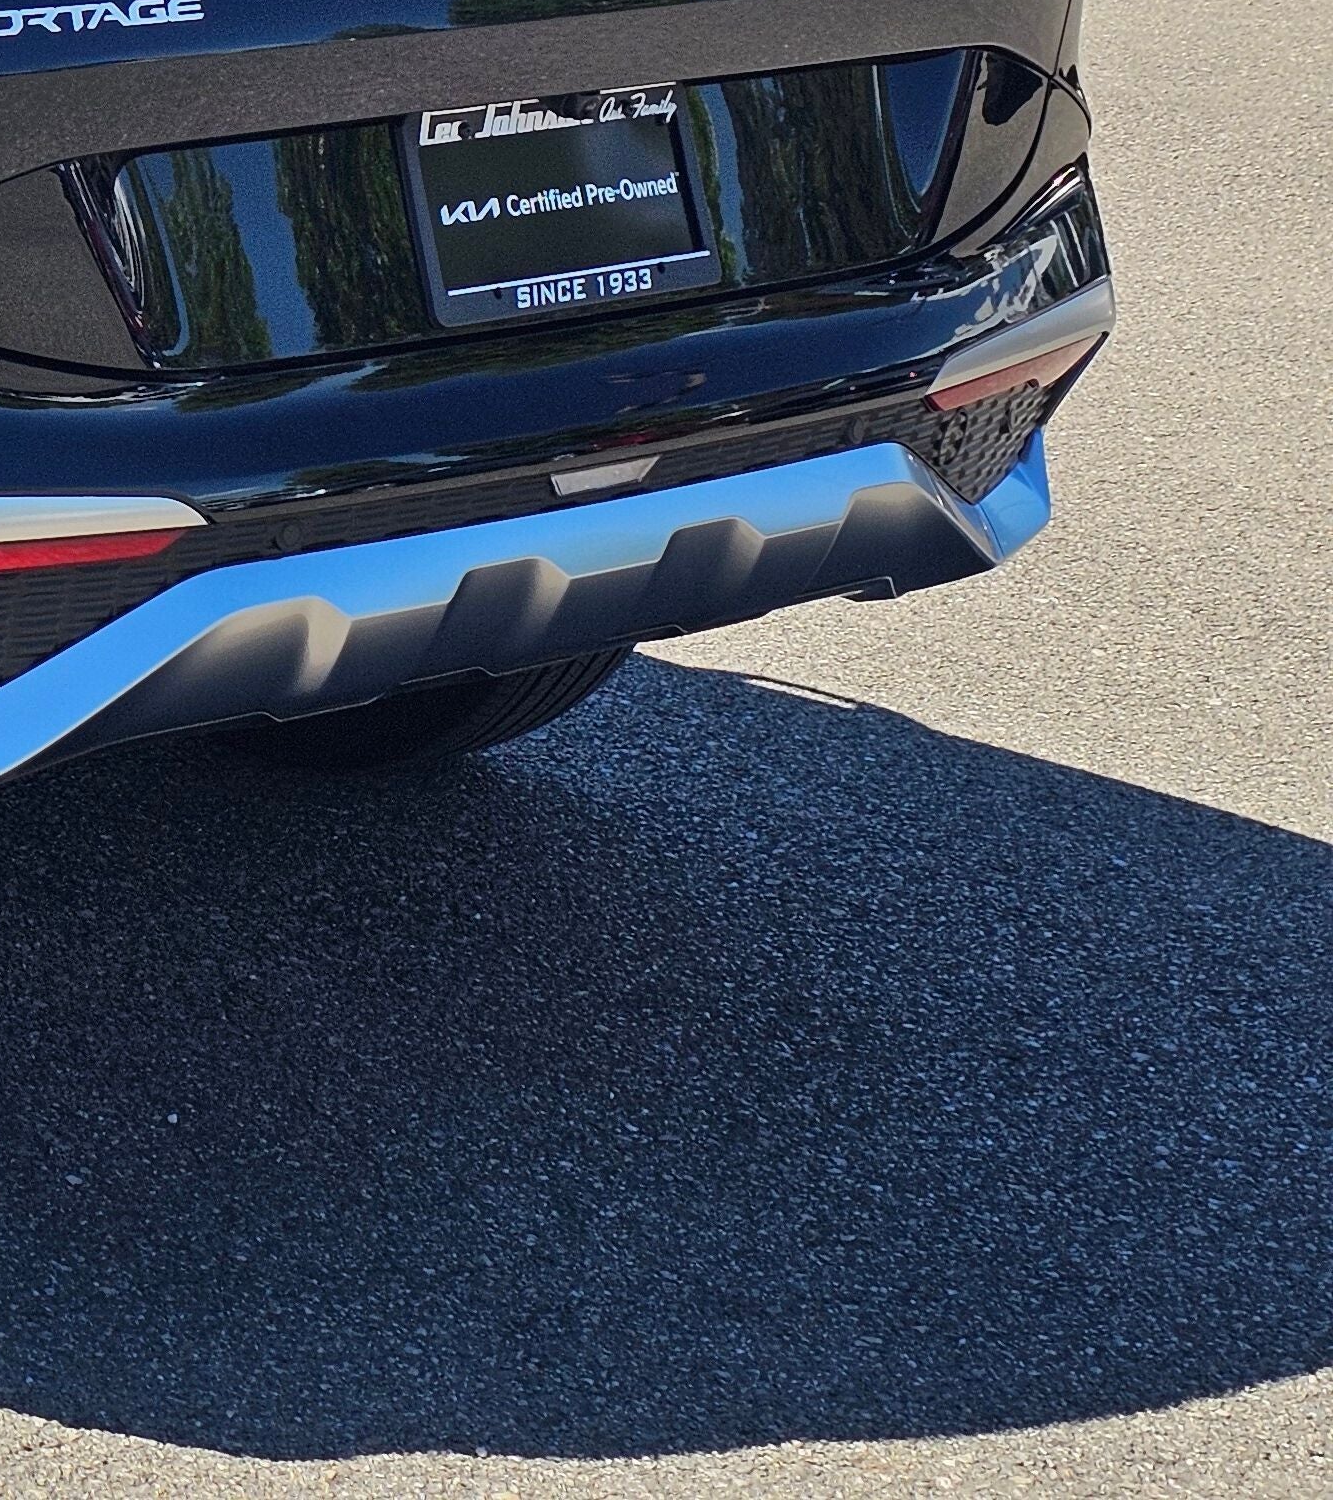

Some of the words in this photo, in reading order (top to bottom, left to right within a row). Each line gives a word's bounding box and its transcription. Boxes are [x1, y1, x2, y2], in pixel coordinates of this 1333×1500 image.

[474, 98, 594, 139] Johns
[630, 89, 677, 123] Family
[440, 197, 501, 226] KIA
[506, 186, 583, 217] Certified
[585, 171, 678, 207] Pre-Owned
[517, 278, 587, 310] SINCE
[597, 267, 652, 298] 1933
